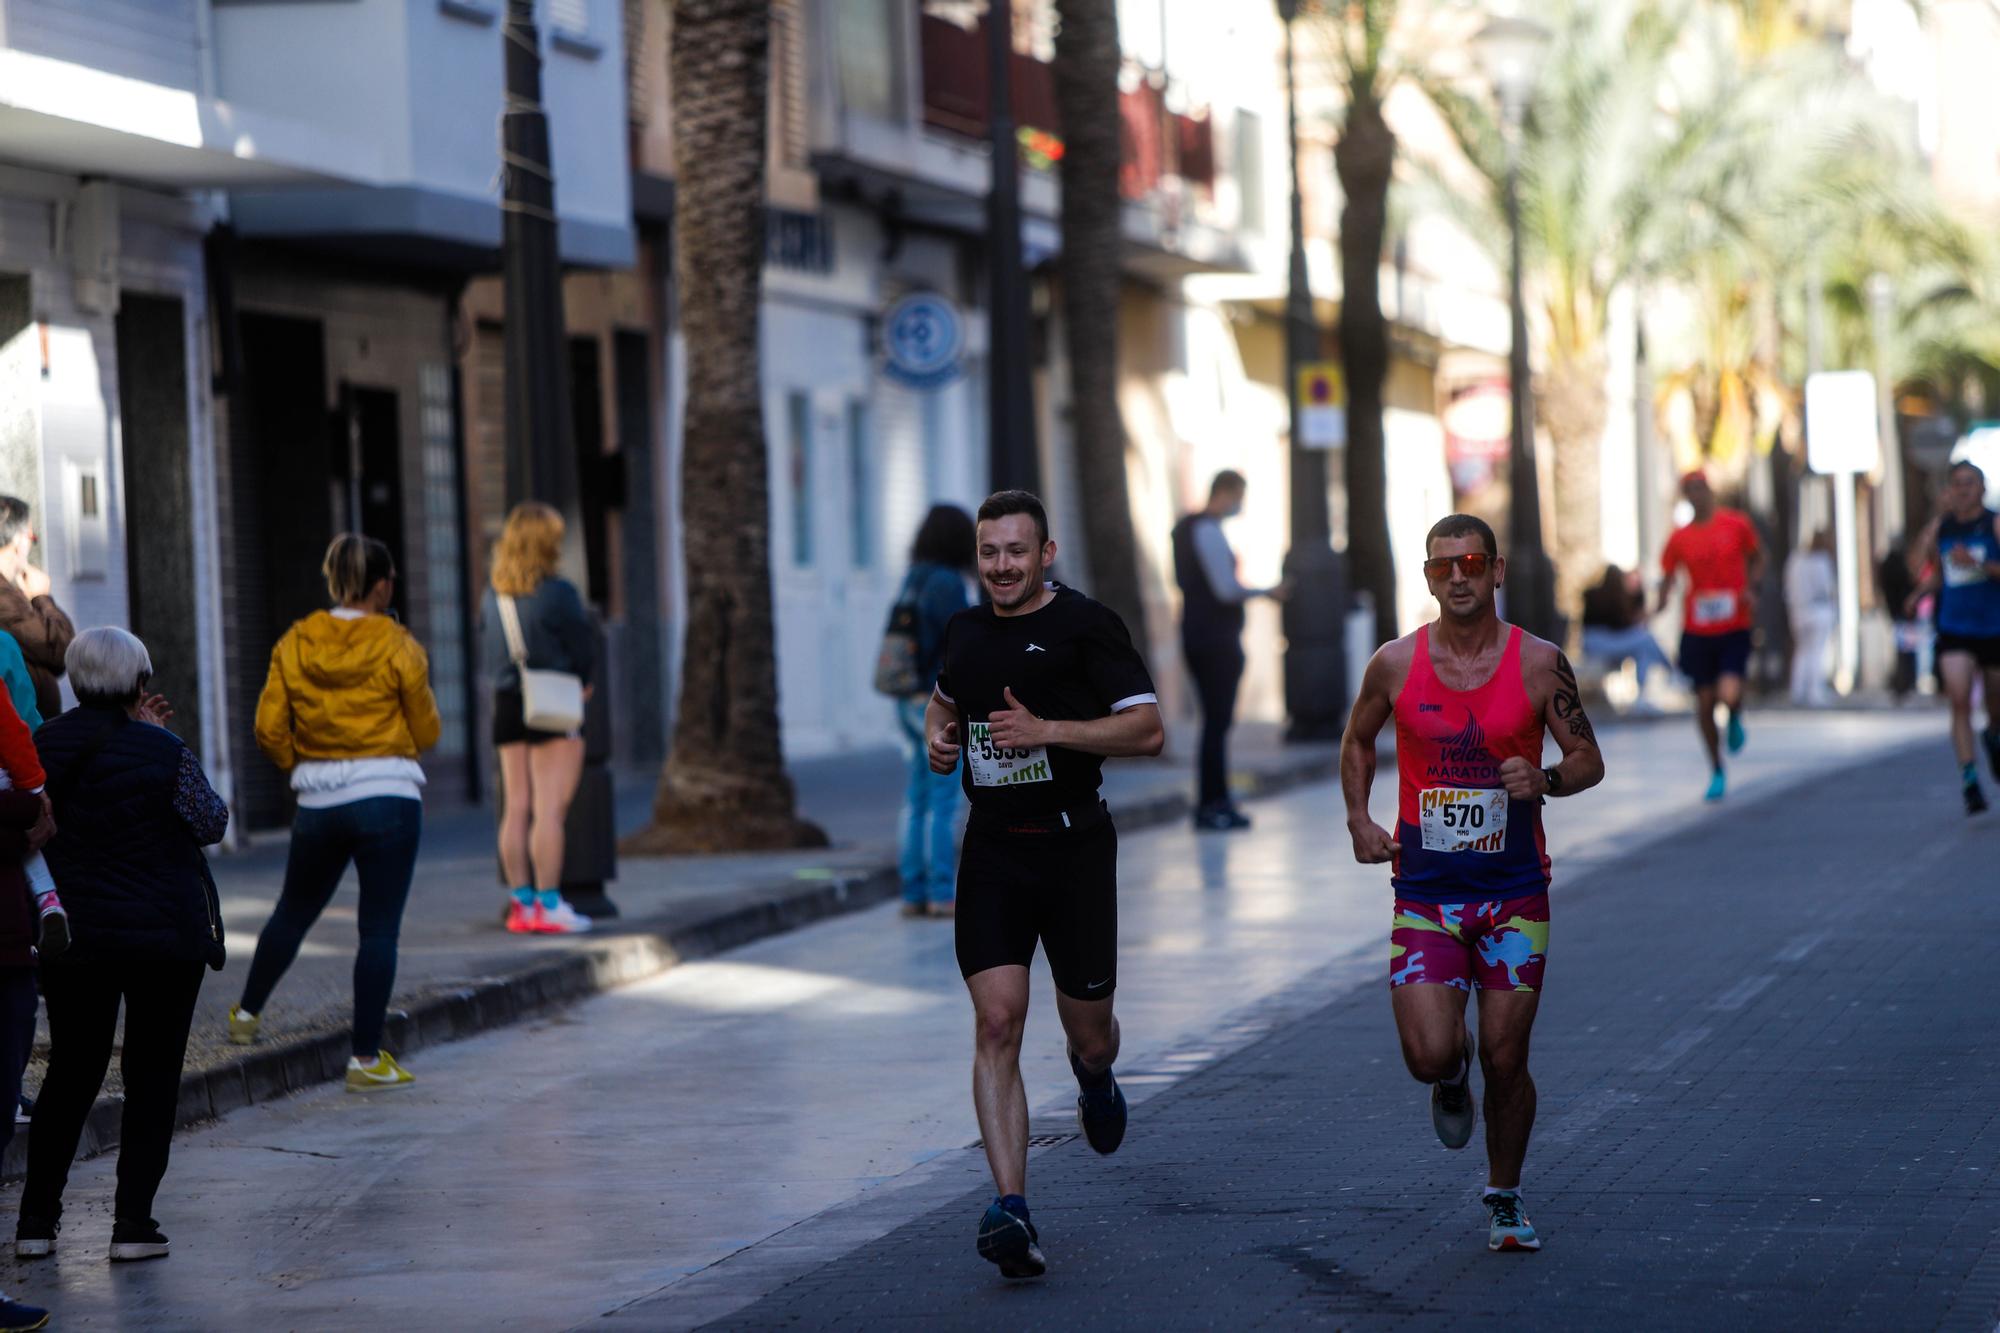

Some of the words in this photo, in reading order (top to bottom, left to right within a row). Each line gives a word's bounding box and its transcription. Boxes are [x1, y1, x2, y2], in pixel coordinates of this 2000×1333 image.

[1441, 745, 1488, 762] velas
[1427, 765, 1501, 778] MARATON
[1444, 804, 1484, 828] 570
